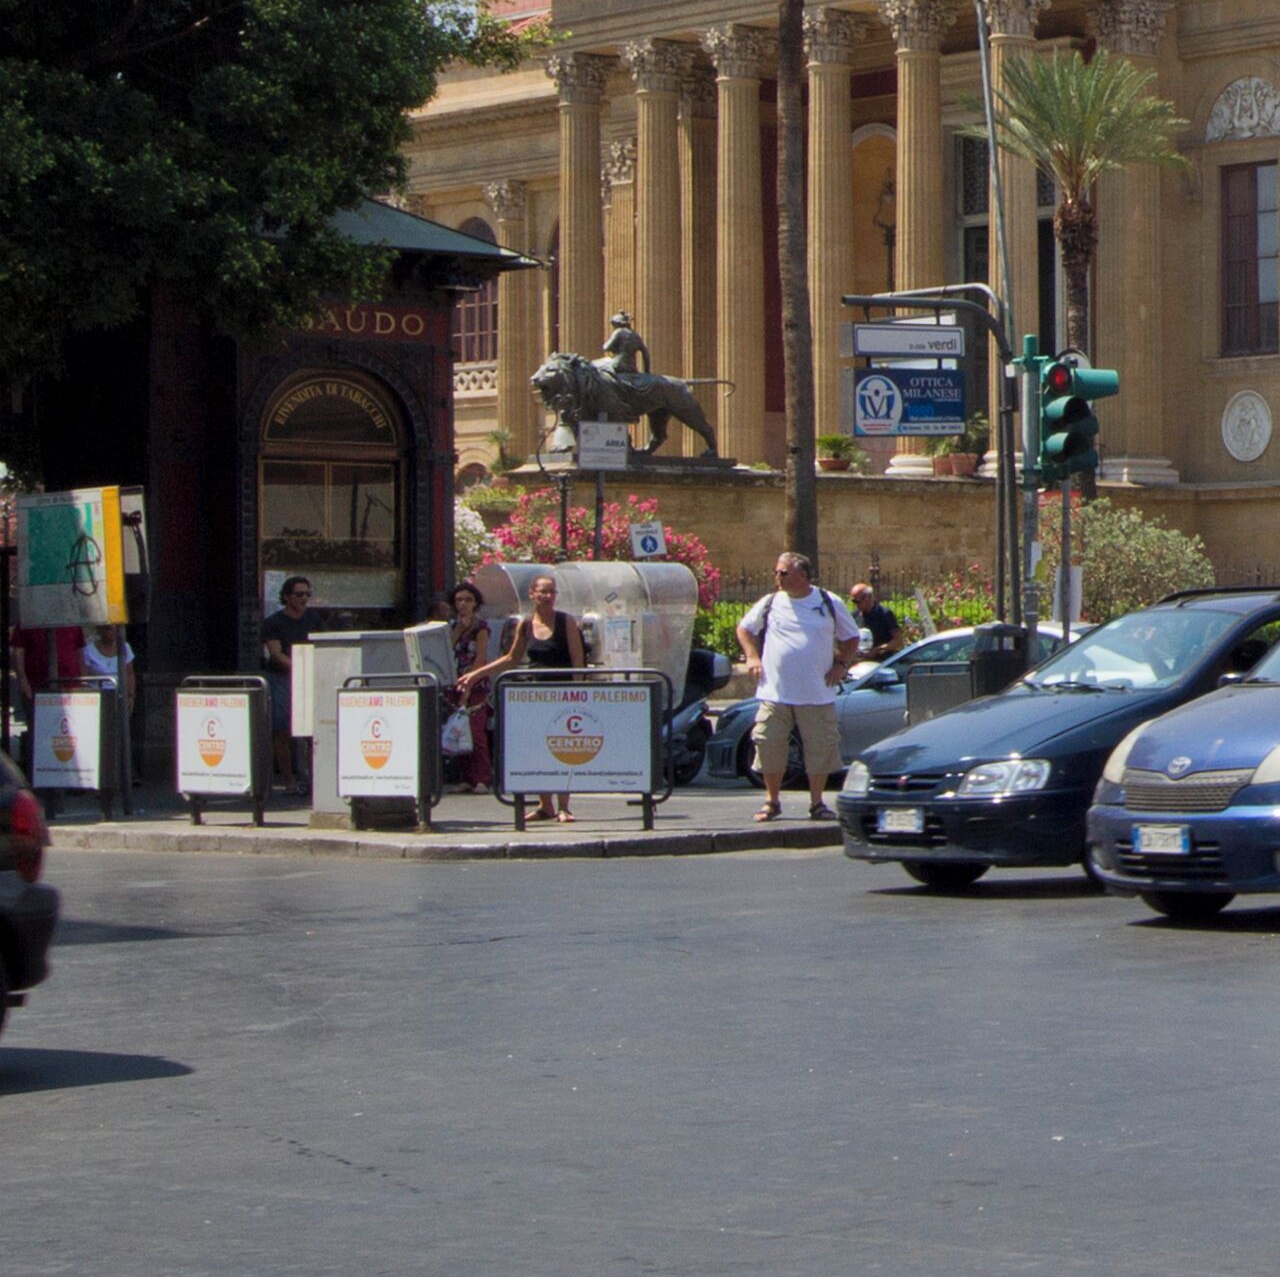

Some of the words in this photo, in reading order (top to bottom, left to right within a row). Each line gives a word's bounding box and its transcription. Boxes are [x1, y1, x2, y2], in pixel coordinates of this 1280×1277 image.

[927, 338, 957, 350] verdi
[909, 377, 953, 388] OTTICA
[902, 388, 961, 399] MILANESE
[507, 690, 588, 703] RIGENERIAMO
[592, 690, 647, 703] PALERMO
[549, 737, 602, 748] CENTRO
